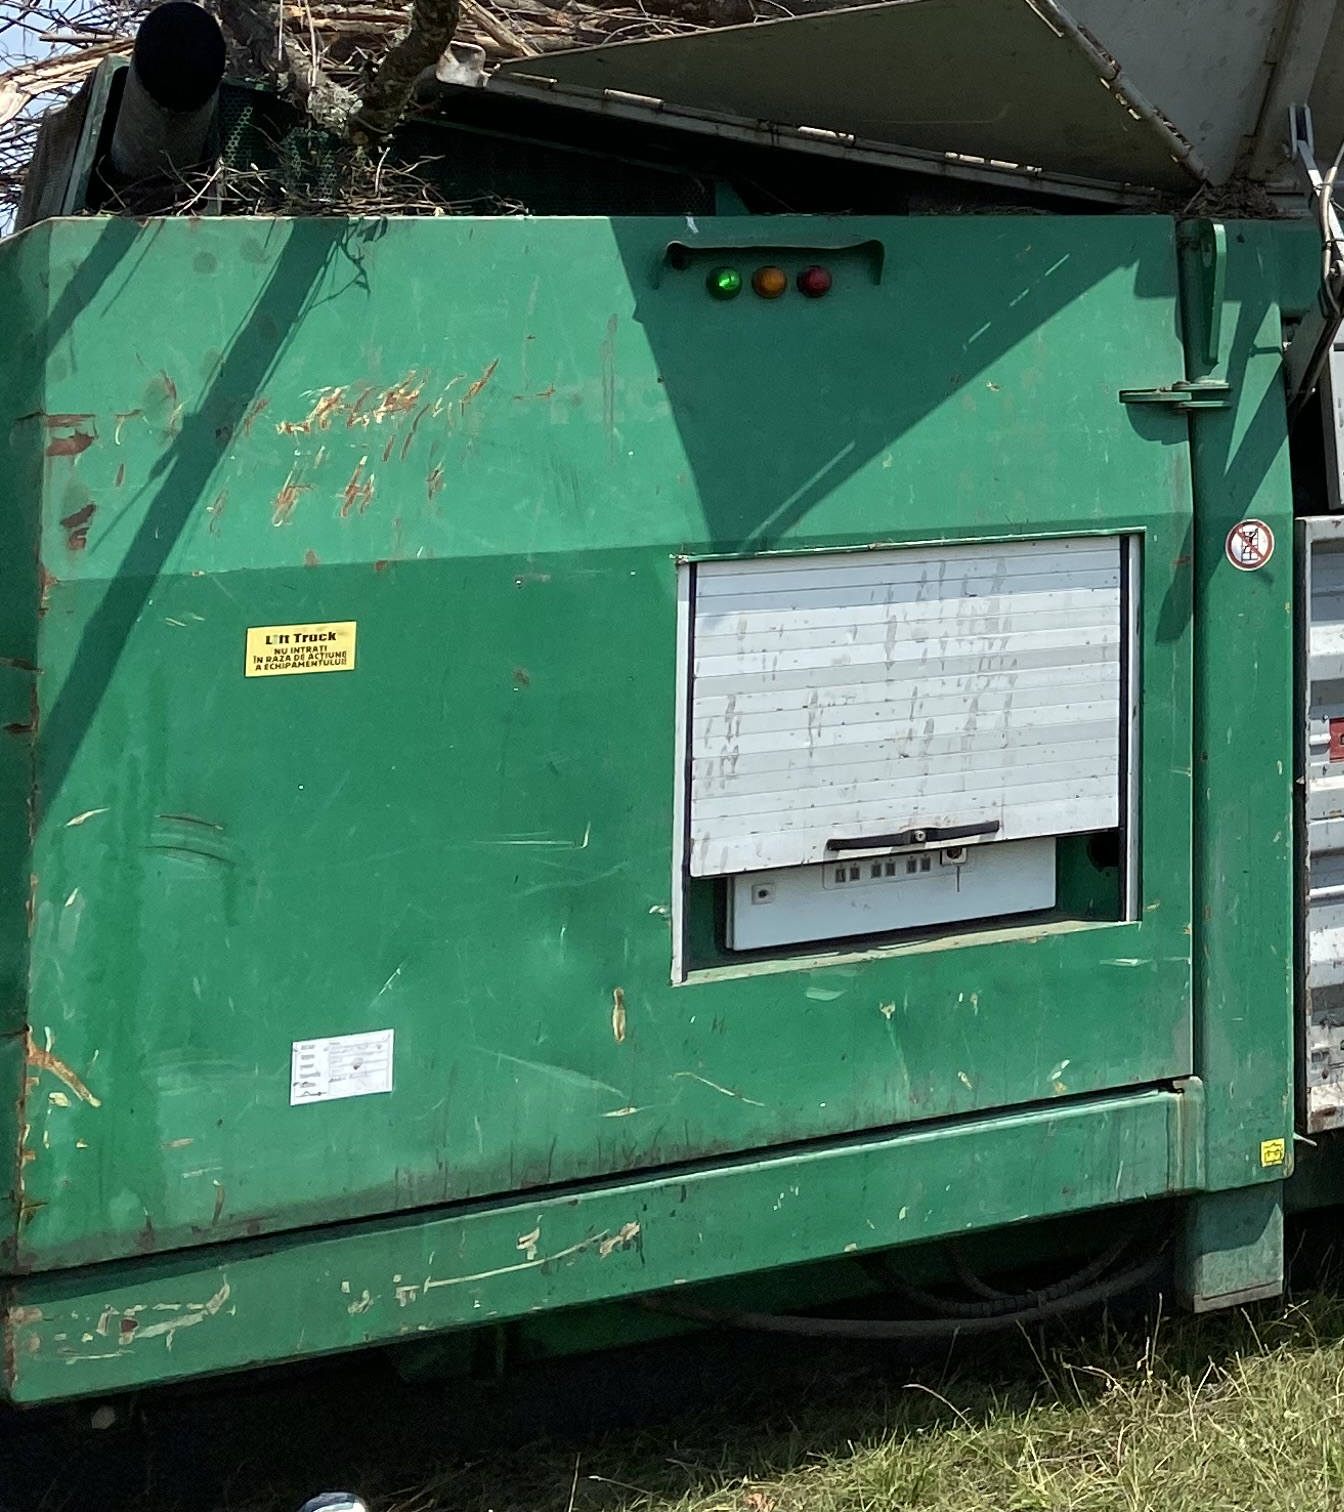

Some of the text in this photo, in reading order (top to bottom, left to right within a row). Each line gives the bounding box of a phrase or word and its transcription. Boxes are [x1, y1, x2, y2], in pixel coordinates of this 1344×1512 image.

[293, 631, 337, 643] Truck
[265, 654, 292, 663] RAZA
[294, 653, 305, 662] DE
